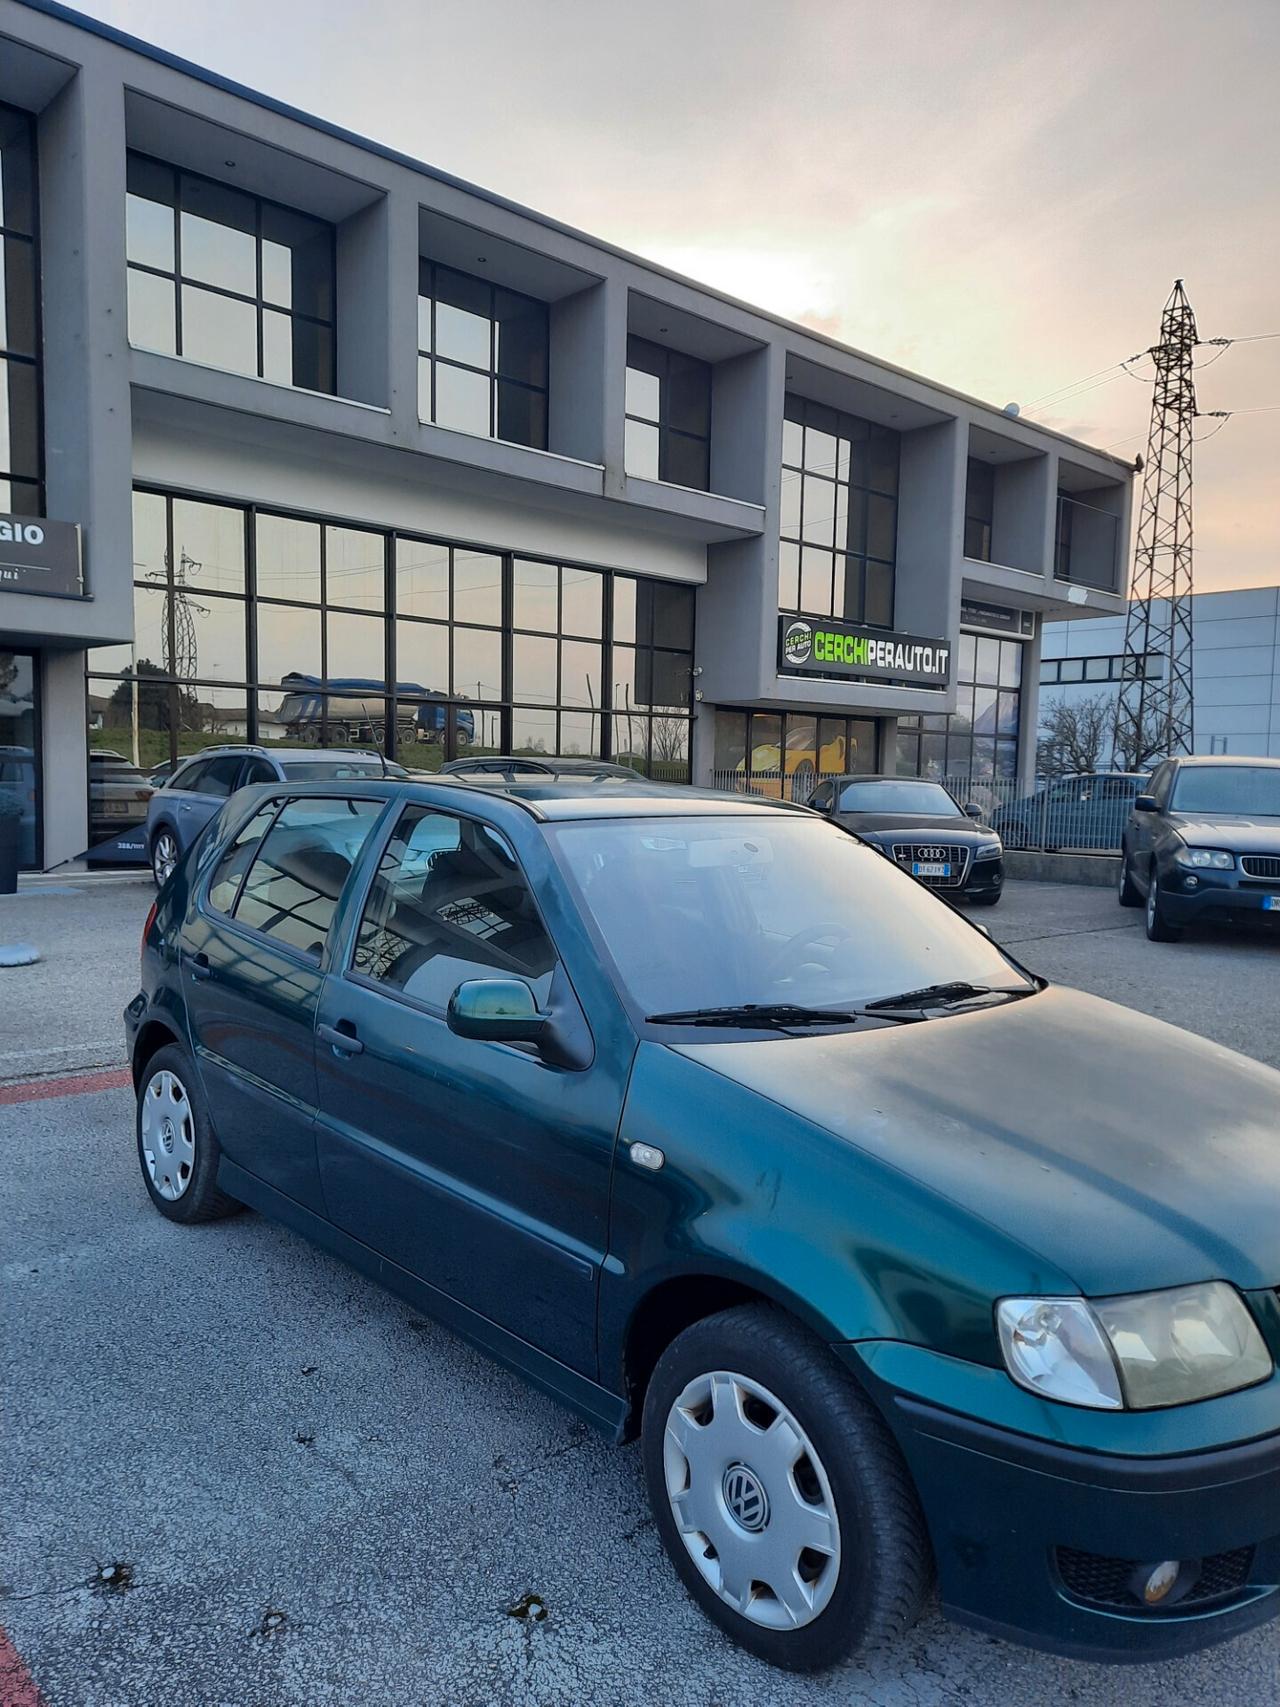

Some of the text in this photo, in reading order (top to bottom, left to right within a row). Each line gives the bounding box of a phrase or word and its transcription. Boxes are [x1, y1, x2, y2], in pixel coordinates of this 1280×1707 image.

[0, 568, 19, 582] ui
[785, 631, 812, 647] CERCHI
[785, 640, 812, 654] PER AUTO
[814, 632, 949, 674] CERCHIPERAUTO.IT
